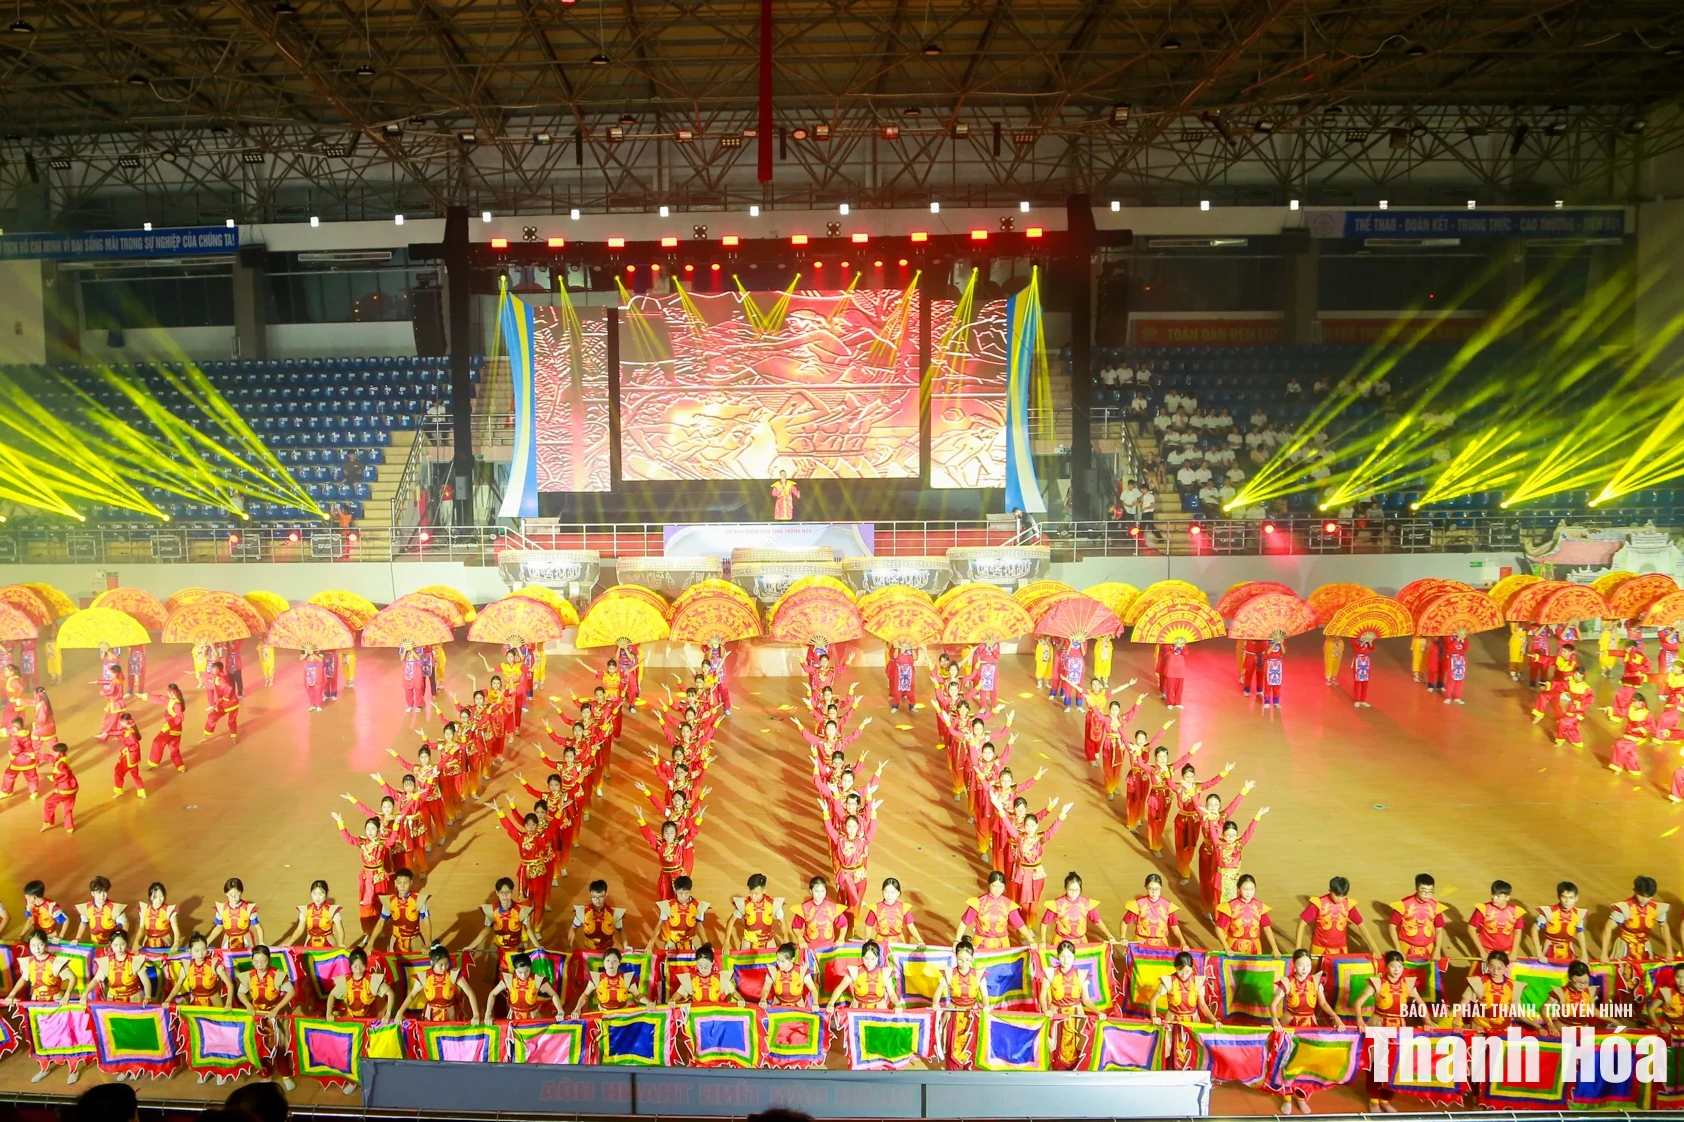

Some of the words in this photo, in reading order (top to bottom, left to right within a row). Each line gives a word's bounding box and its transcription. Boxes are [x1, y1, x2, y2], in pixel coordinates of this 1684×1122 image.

[1374, 218, 1396, 232] THAO
[84, 234, 104, 252] SỐNG
[120, 236, 143, 250] TRONG
[144, 236, 154, 252] SỰ
[155, 233, 181, 252] NGHIỆP
[182, 231, 197, 248] CỦA
[198, 231, 223, 248] CHÚNG
[224, 233, 235, 247] TA!
